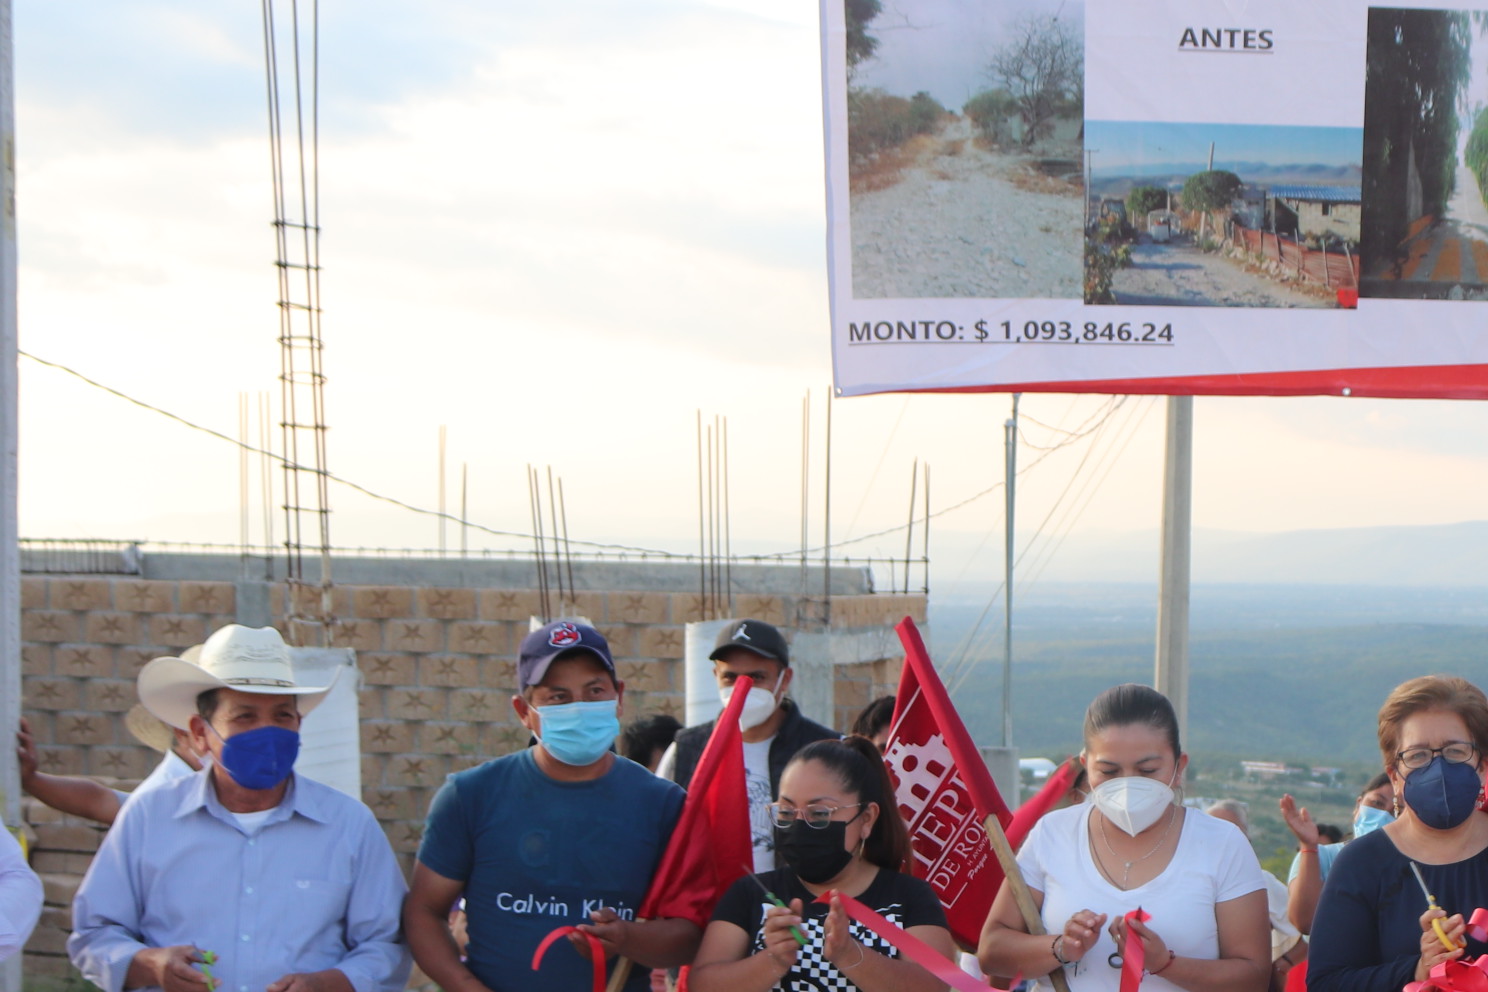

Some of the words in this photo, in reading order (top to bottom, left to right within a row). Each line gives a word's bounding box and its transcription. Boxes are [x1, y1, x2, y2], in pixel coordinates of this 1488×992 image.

[1179, 27, 1274, 49] ANTES
[849, 320, 964, 342] MONTO:
[974, 318, 989, 343] $
[1000, 320, 1174, 344] 1,093,846.24
[932, 859, 961, 891] DE
[497, 892, 568, 916] Calvin
